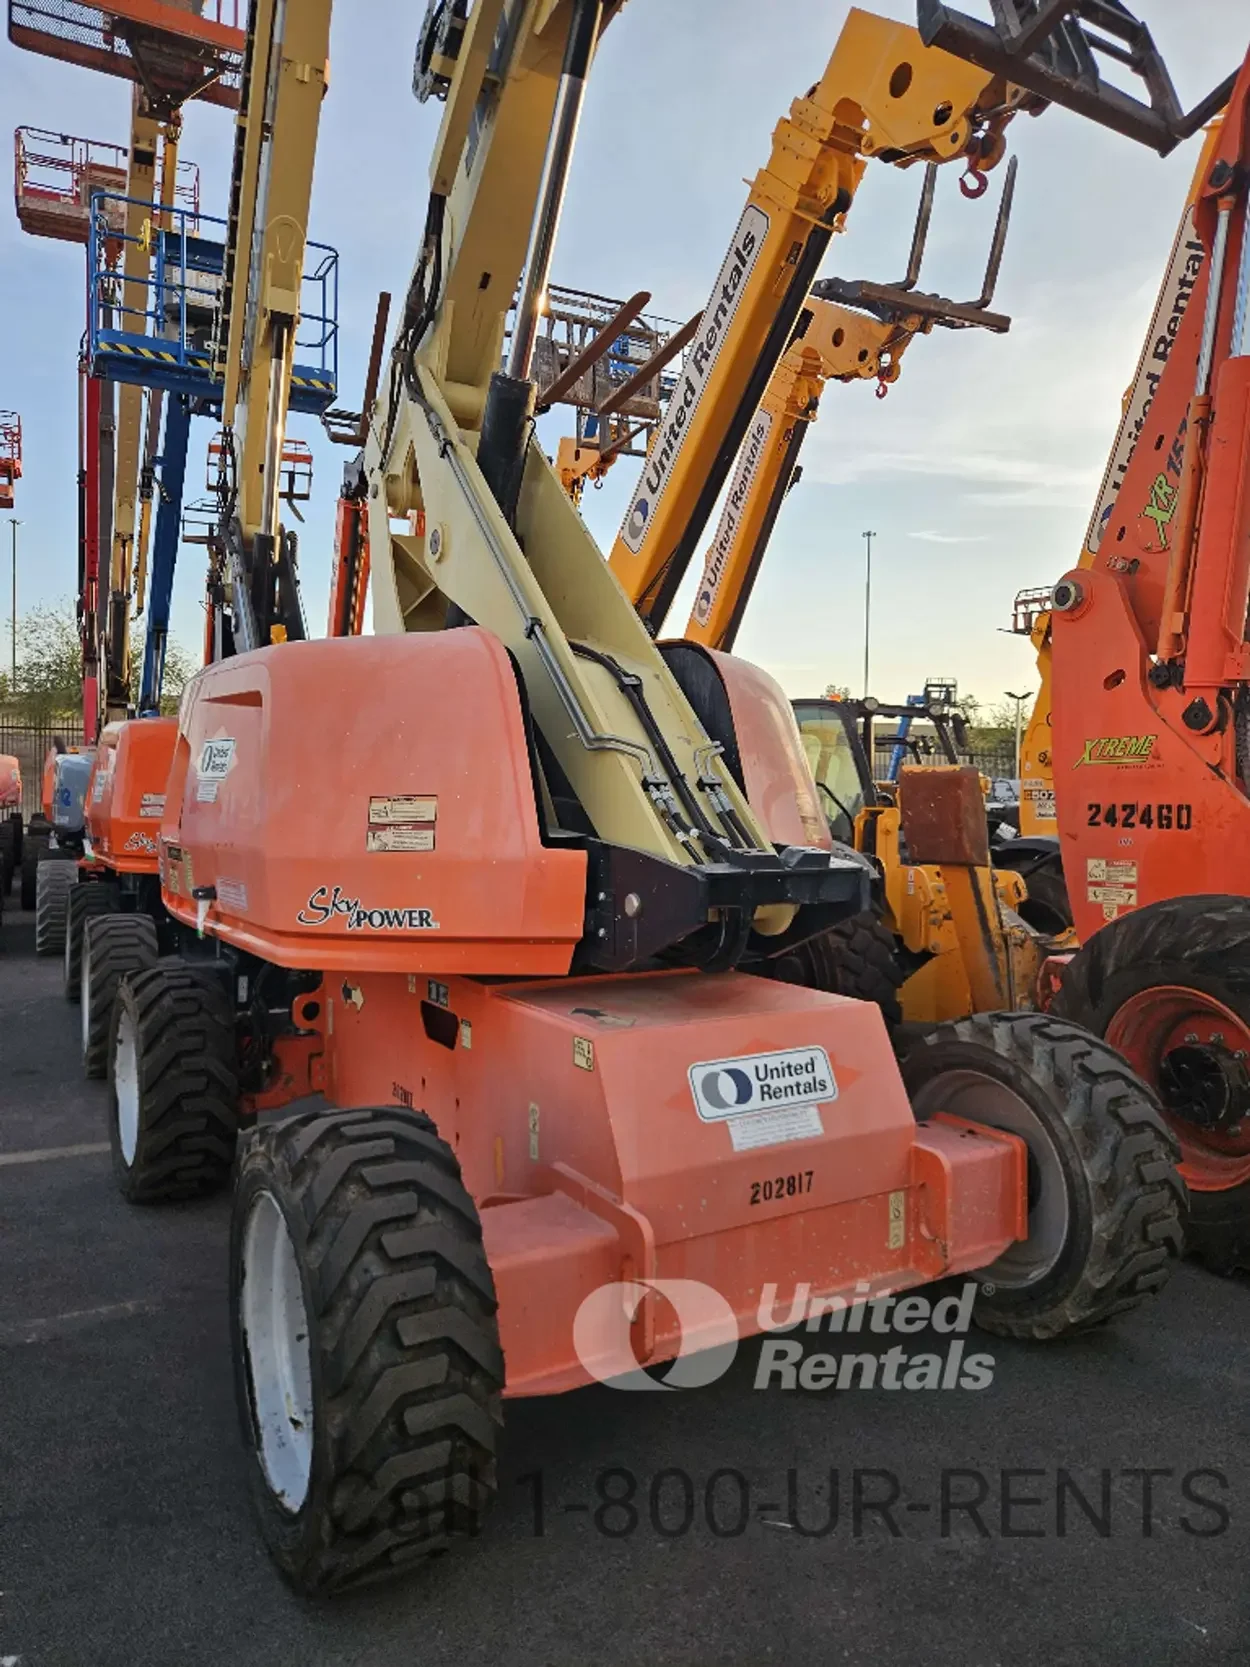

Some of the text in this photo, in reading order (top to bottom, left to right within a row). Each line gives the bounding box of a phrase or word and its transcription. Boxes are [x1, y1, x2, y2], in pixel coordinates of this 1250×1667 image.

[646, 230, 756, 495] United Rentals
[707, 513, 736, 588] United
[1072, 734, 1159, 771] XTREME
[1087, 803, 1192, 831] 242460
[754, 1056, 816, 1082] United
[760, 1076, 828, 1102] Rentals
[750, 1170, 814, 1206] 202817
